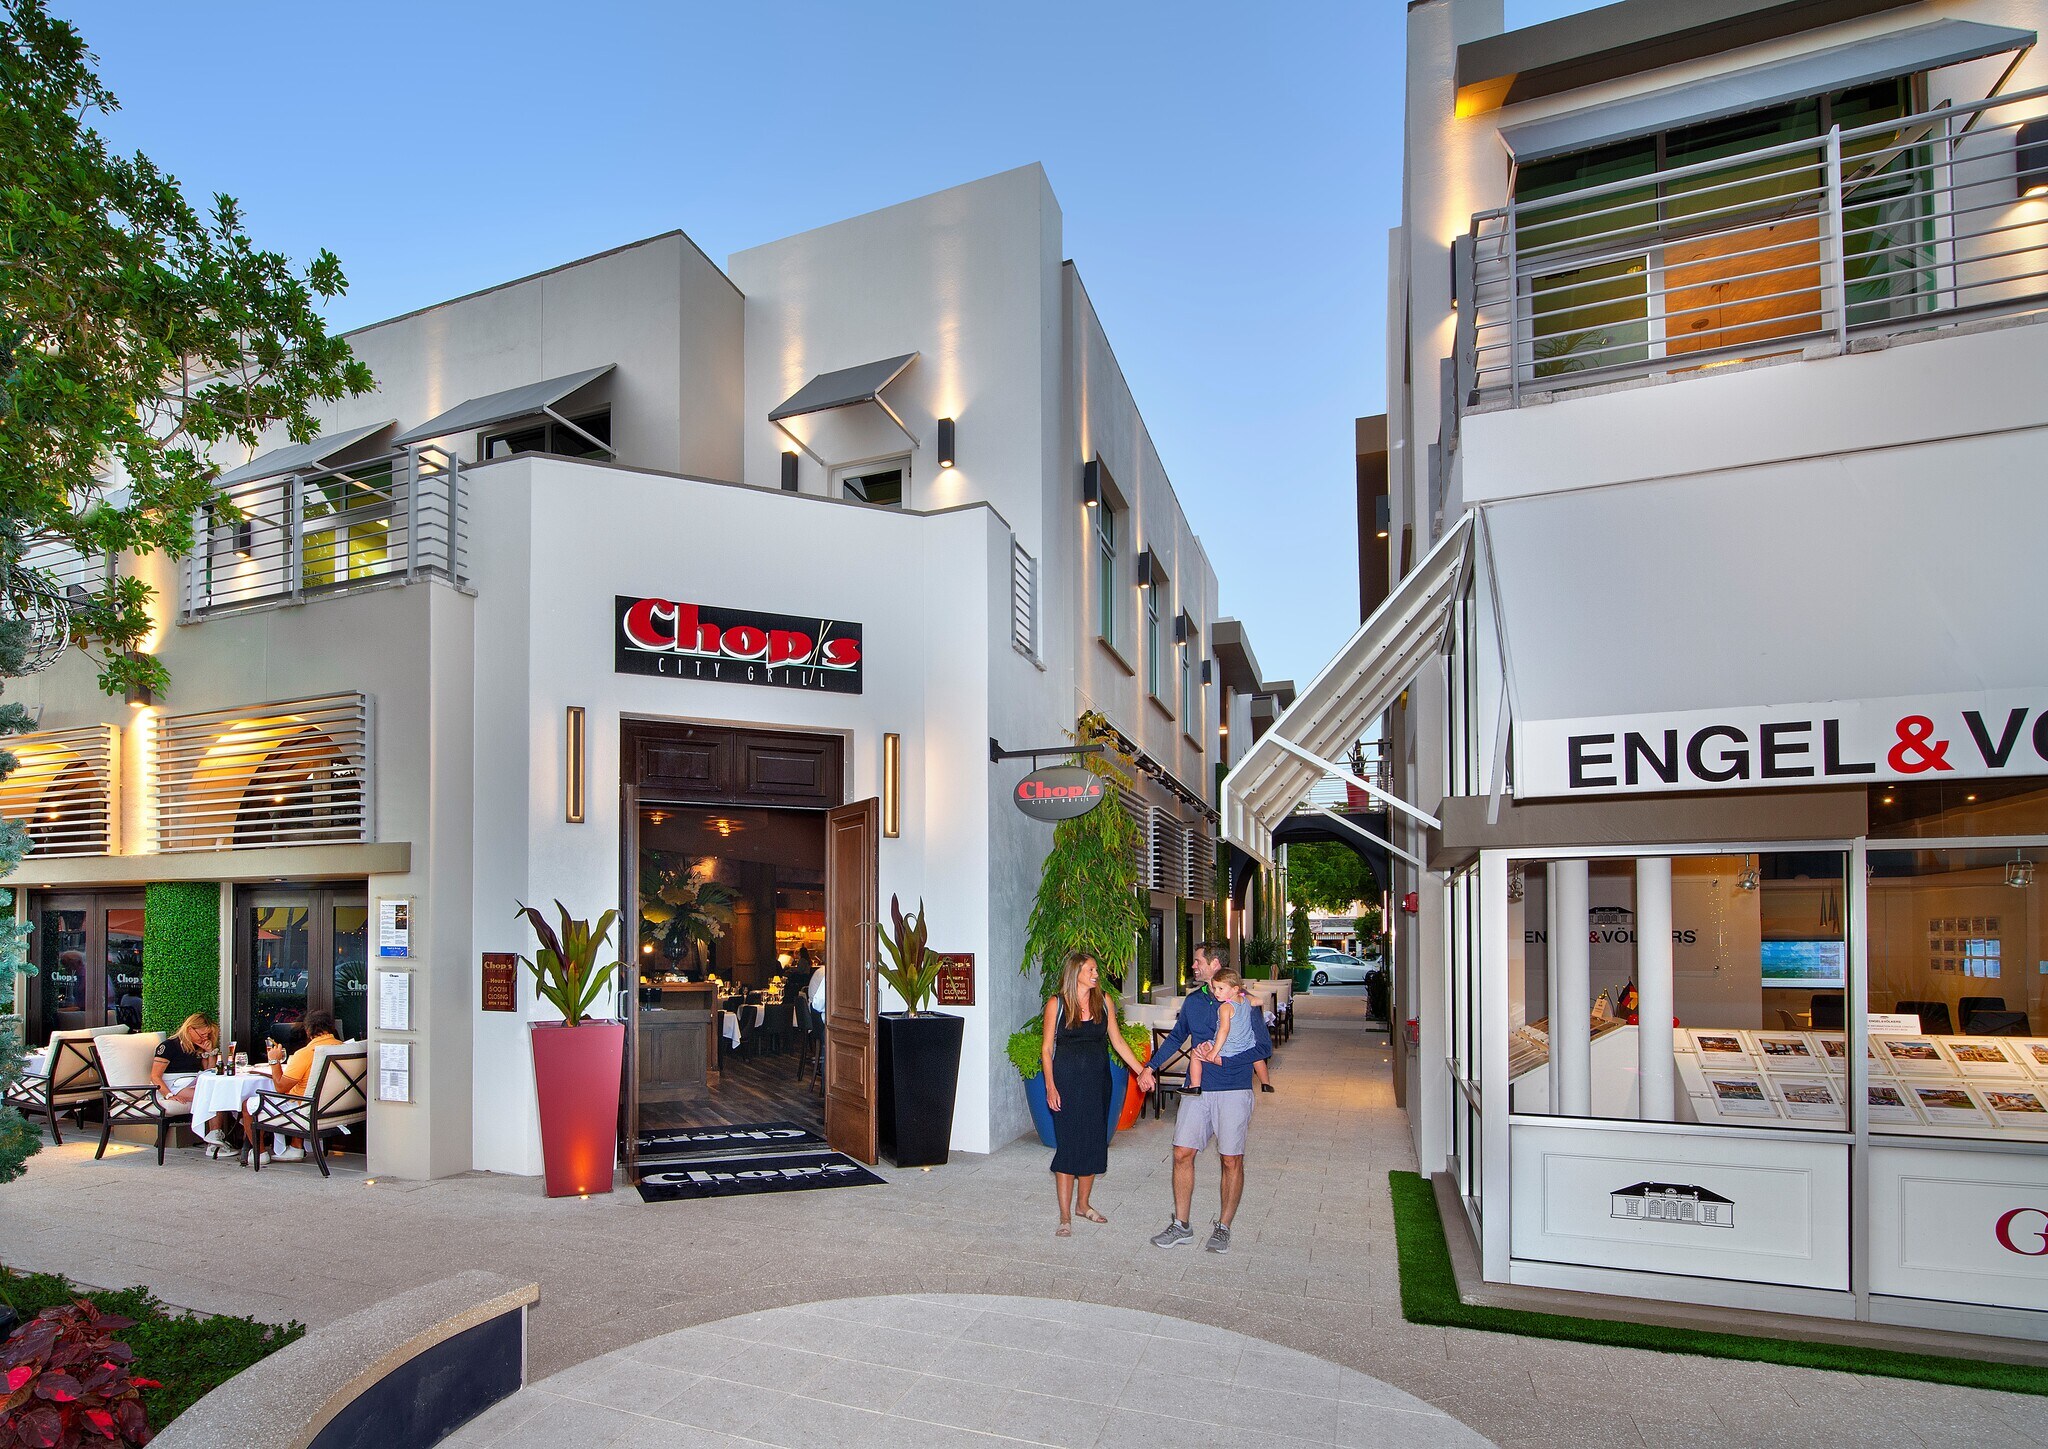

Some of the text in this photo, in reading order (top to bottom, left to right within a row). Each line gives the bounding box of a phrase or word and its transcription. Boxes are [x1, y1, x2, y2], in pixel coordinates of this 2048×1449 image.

[623, 598, 861, 669] Chop's
[658, 657, 825, 688] CITY GRILL
[1018, 775, 1101, 799] Chop's
[262, 975, 297, 988] Chop's
